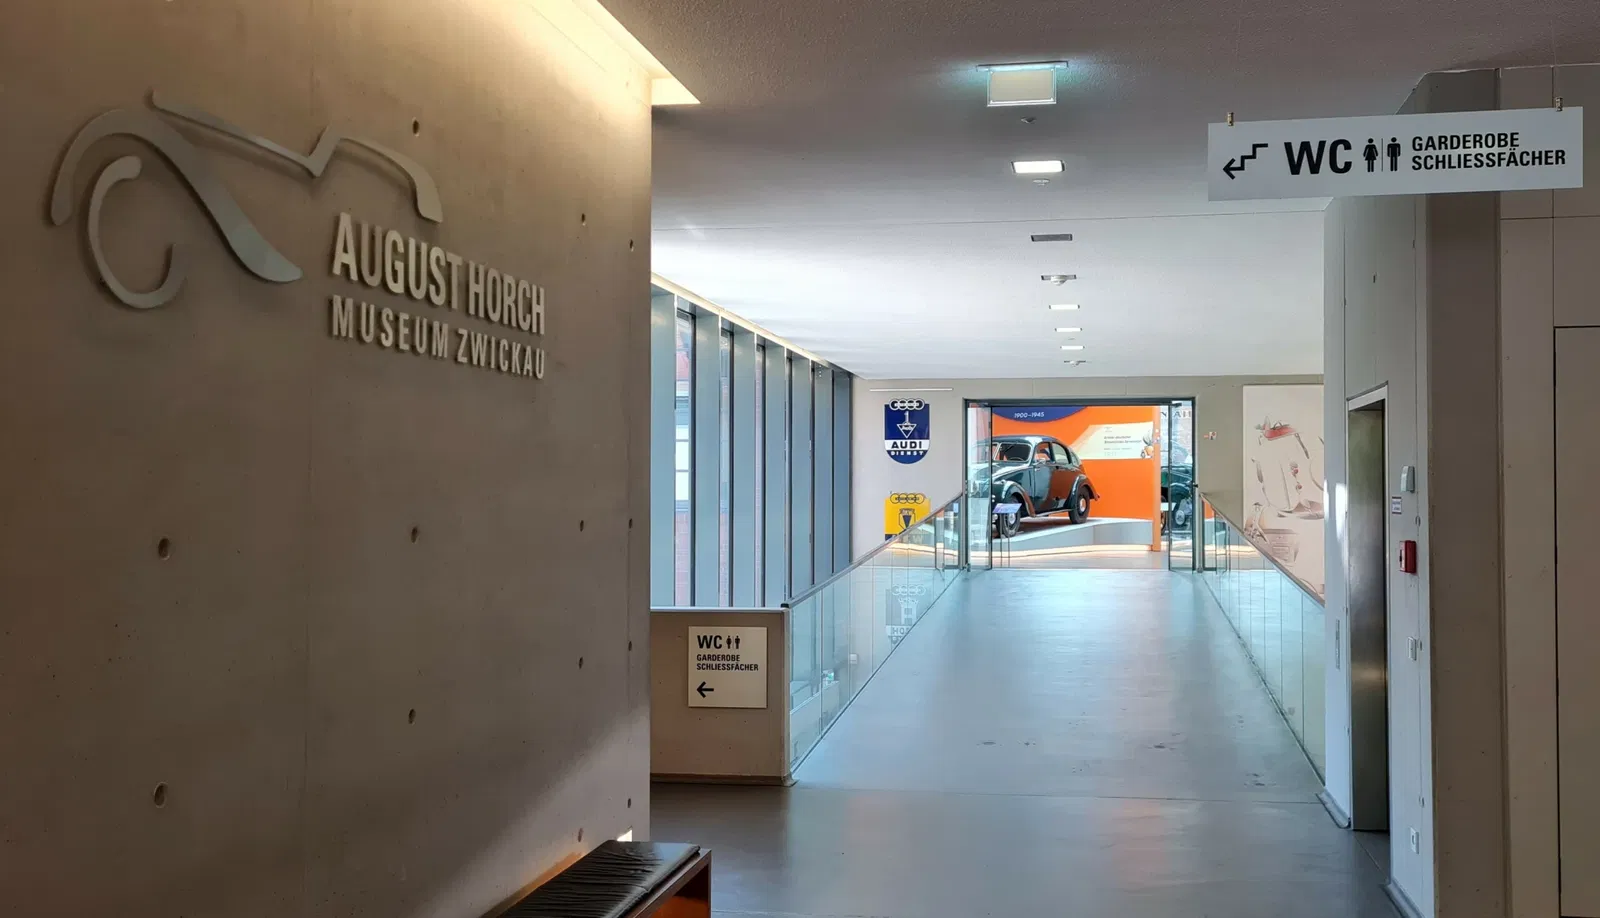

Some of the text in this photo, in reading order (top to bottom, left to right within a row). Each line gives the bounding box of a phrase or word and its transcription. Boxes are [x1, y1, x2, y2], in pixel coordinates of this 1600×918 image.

[1412, 132, 1520, 152] GARDEROBE
[1284, 139, 1352, 175] WC
[1411, 147, 1566, 171] SCHLIESSFÄCHER
[332, 211, 545, 335] AUGUST HORCH
[332, 294, 545, 379] MUSEUM ZWICKAU
[891, 441, 922, 449] AUDI
[697, 635, 722, 649] WC
[696, 654, 740, 662] GARDEROBE
[696, 662, 759, 671] SCHLIESSFÄCHER
